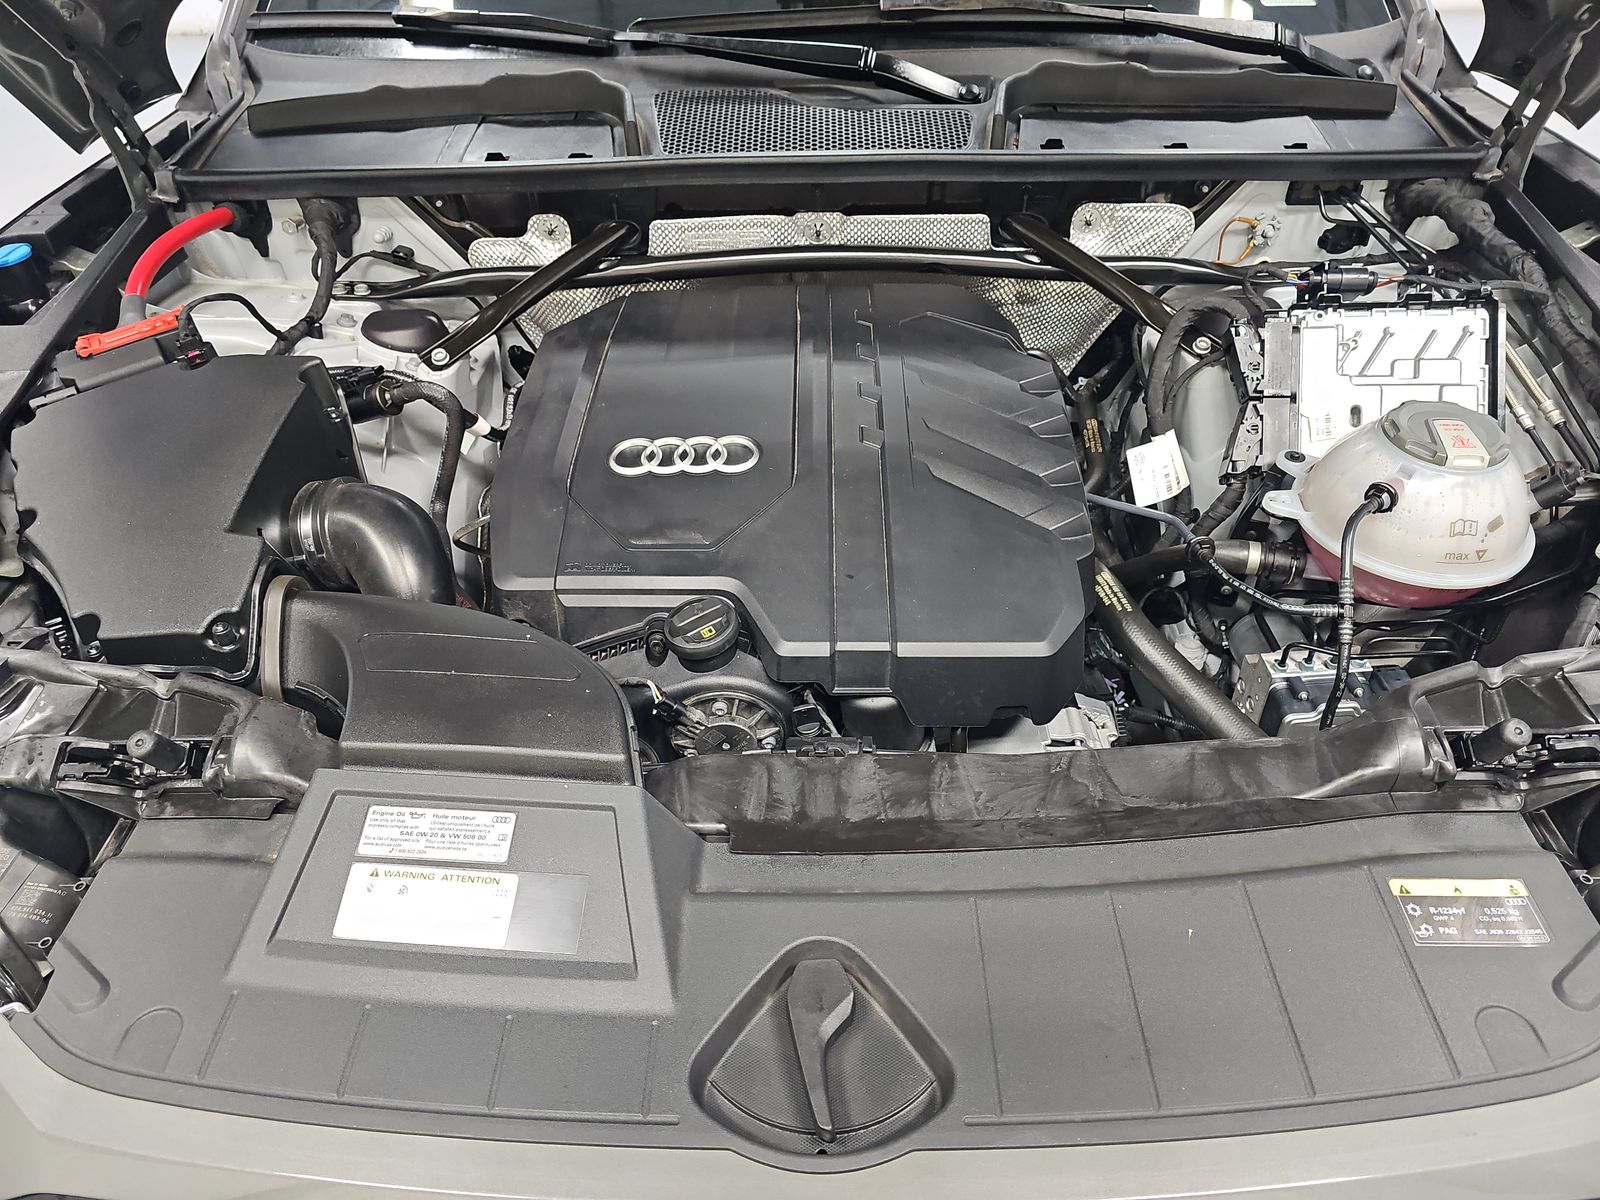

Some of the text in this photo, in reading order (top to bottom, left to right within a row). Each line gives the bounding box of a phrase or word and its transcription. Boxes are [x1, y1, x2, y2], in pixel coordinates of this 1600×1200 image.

[1444, 551, 1470, 561] max
[383, 870, 500, 885] WARNING ATTENTION
[1438, 927, 1458, 935] PAG
